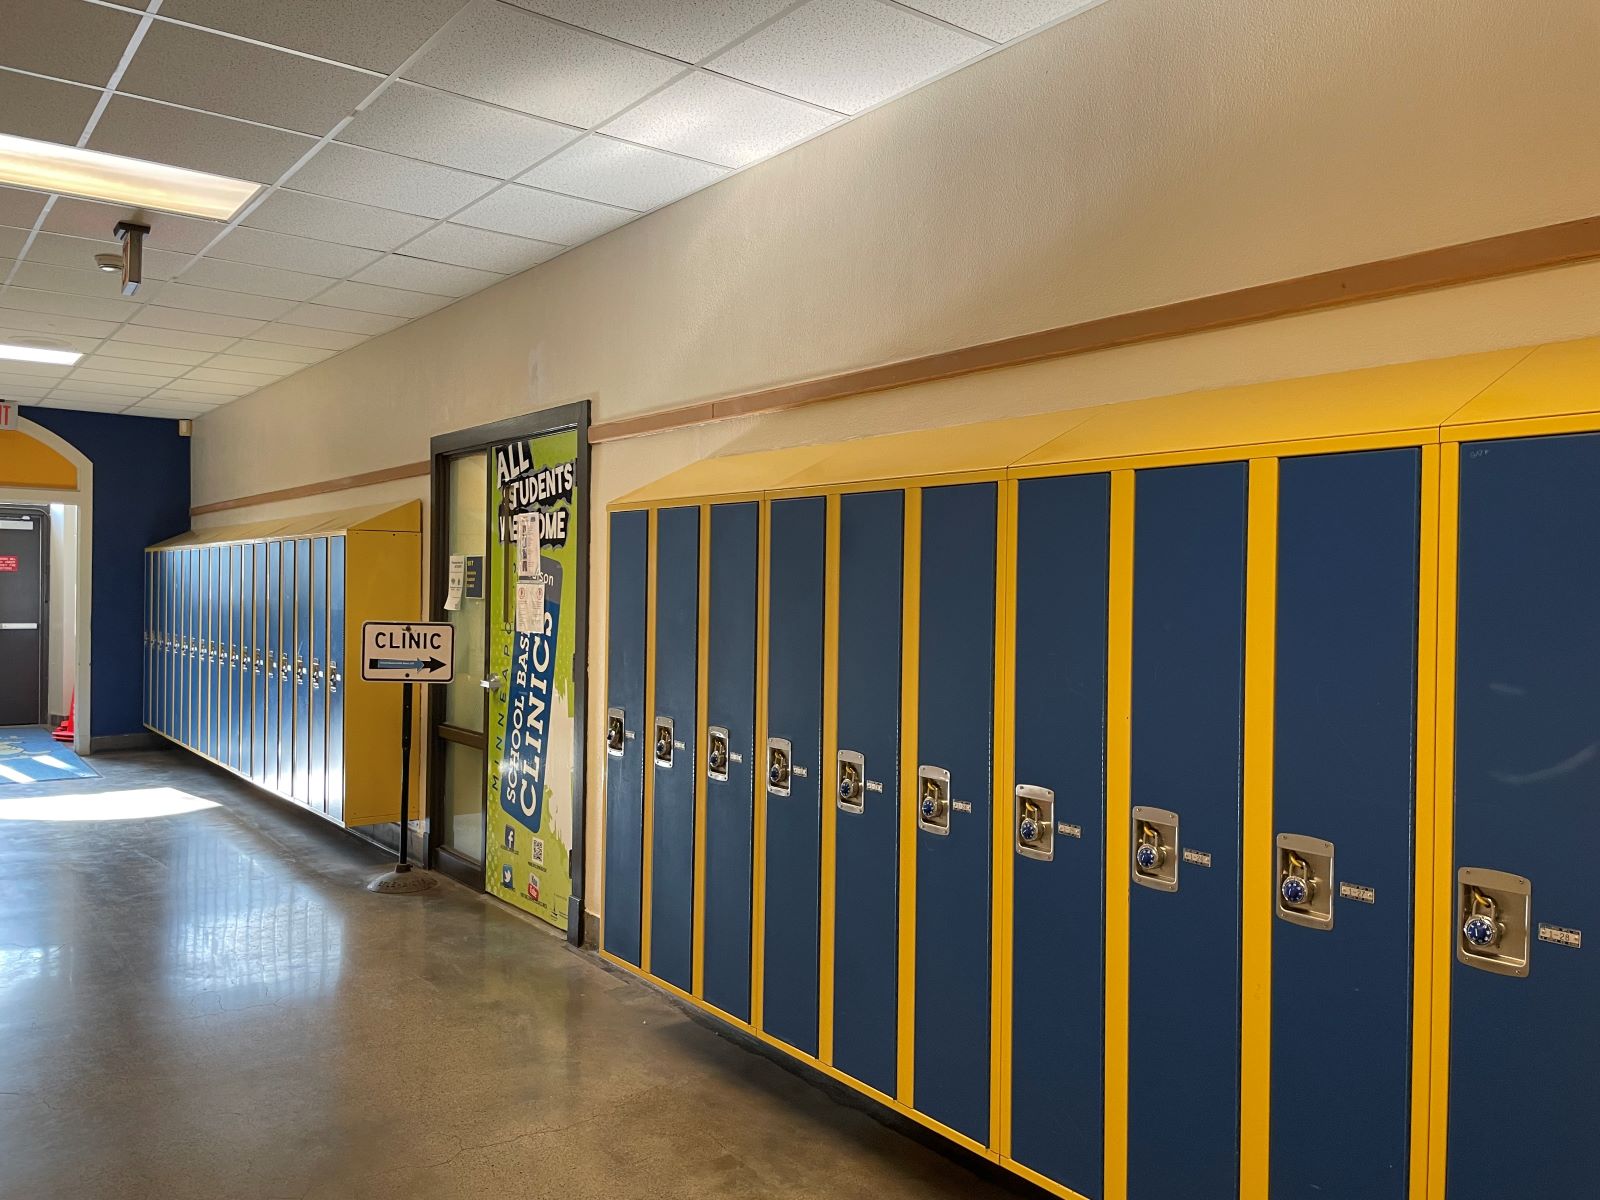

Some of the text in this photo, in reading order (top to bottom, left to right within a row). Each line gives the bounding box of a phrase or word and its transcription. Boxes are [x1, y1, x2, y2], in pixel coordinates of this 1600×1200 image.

[497, 441, 530, 490] ALL
[504, 463, 573, 511] STUDENTS
[375, 632, 441, 650] CLINIC
[506, 695, 525, 804] SCHOOL
